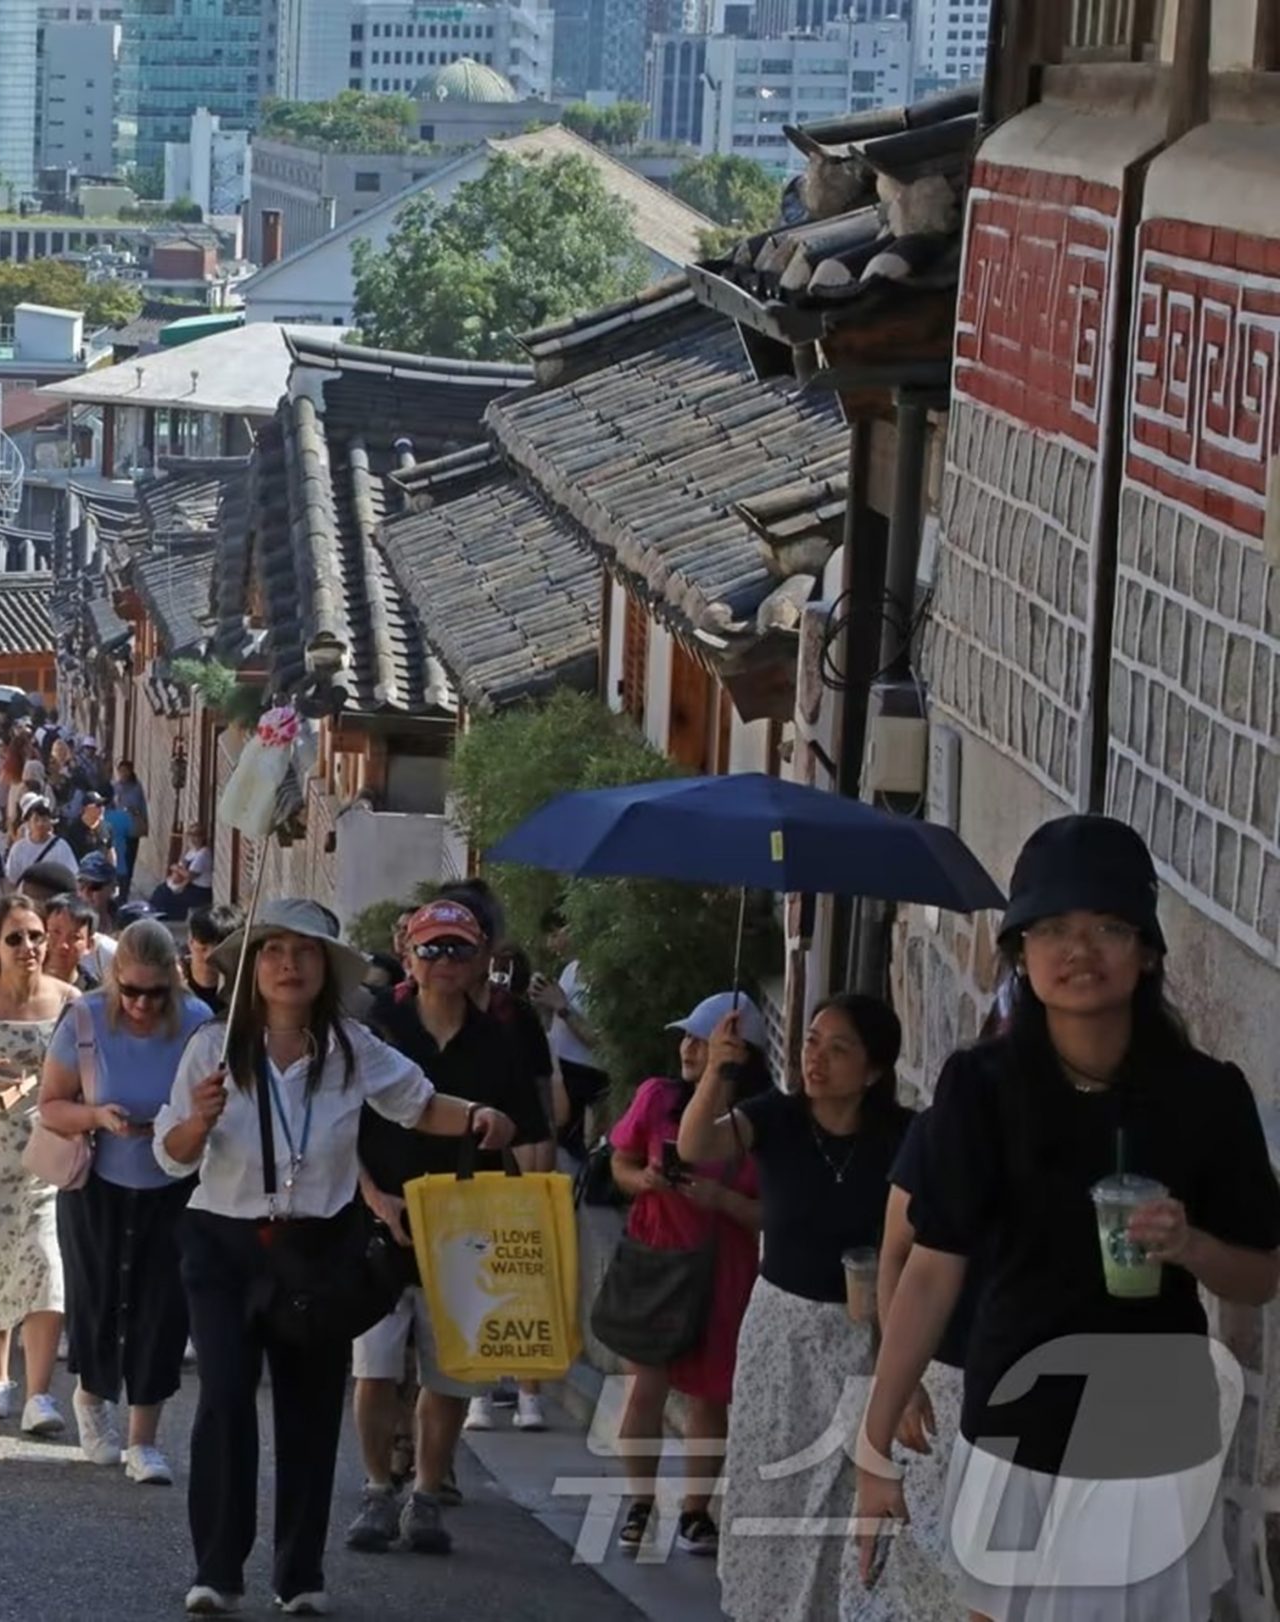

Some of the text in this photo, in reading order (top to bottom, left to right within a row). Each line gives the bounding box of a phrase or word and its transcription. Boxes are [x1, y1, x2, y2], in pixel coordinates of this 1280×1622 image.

[493, 1230, 542, 1244] I LOVE
[495, 1246, 543, 1260] CLEAN
[485, 1320, 552, 1341] SAVE
[480, 1344, 553, 1358] OUR LIFE!
